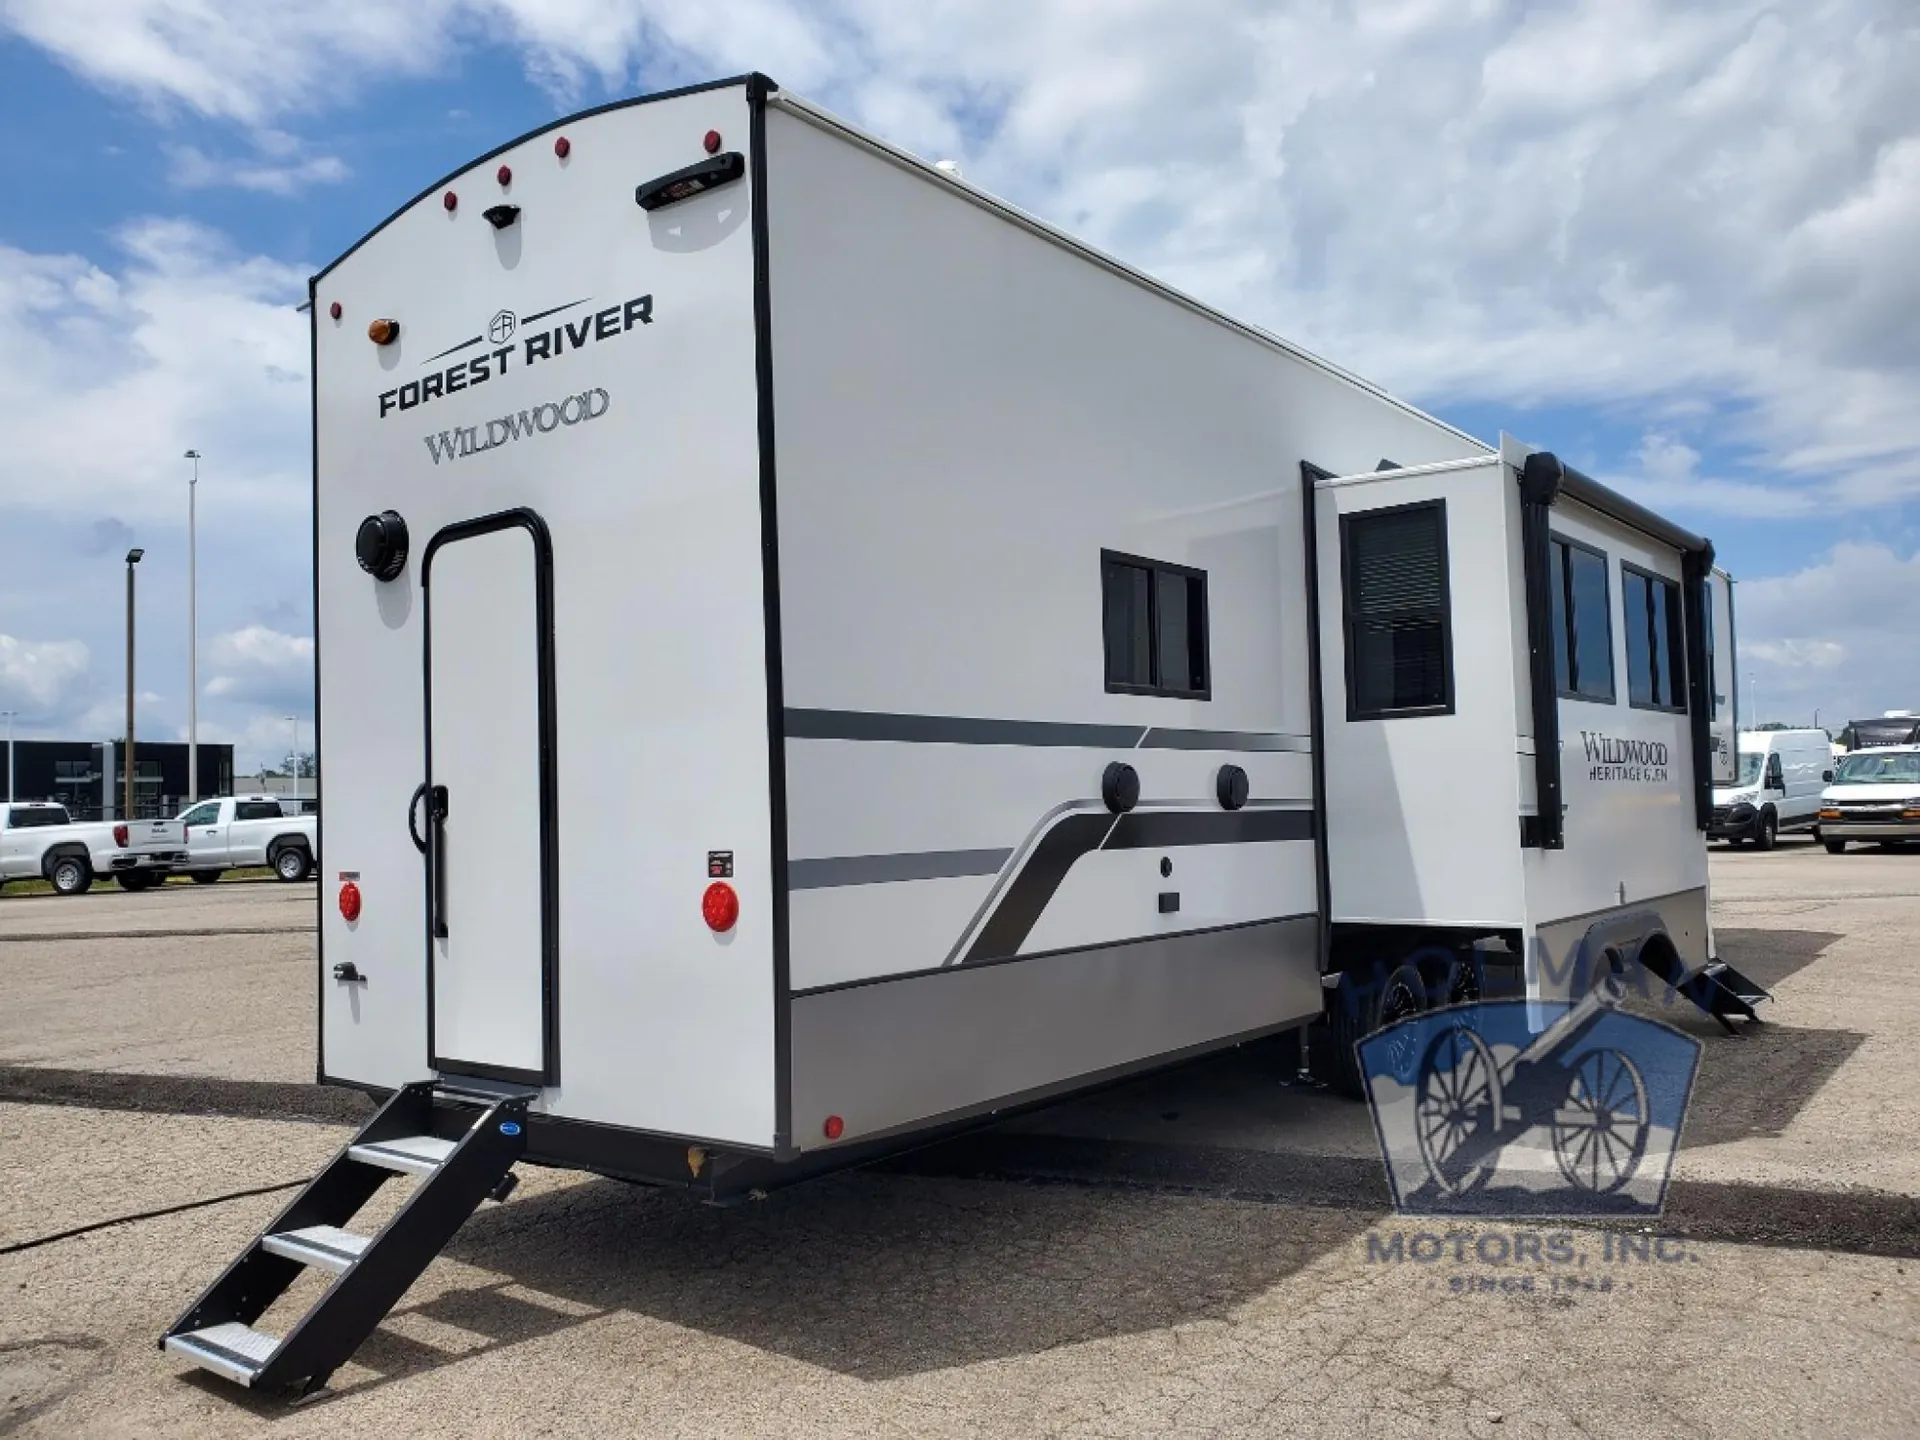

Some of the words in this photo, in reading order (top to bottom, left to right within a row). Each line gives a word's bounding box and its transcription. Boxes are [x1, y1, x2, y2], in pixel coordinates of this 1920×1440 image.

[379, 344, 516, 418] FOREST
[524, 294, 654, 366] RIVER
[423, 387, 611, 466] WILDWOOD
[1580, 730, 1668, 766] WILDWOOD
[1589, 766, 1640, 781] HERITAGE
